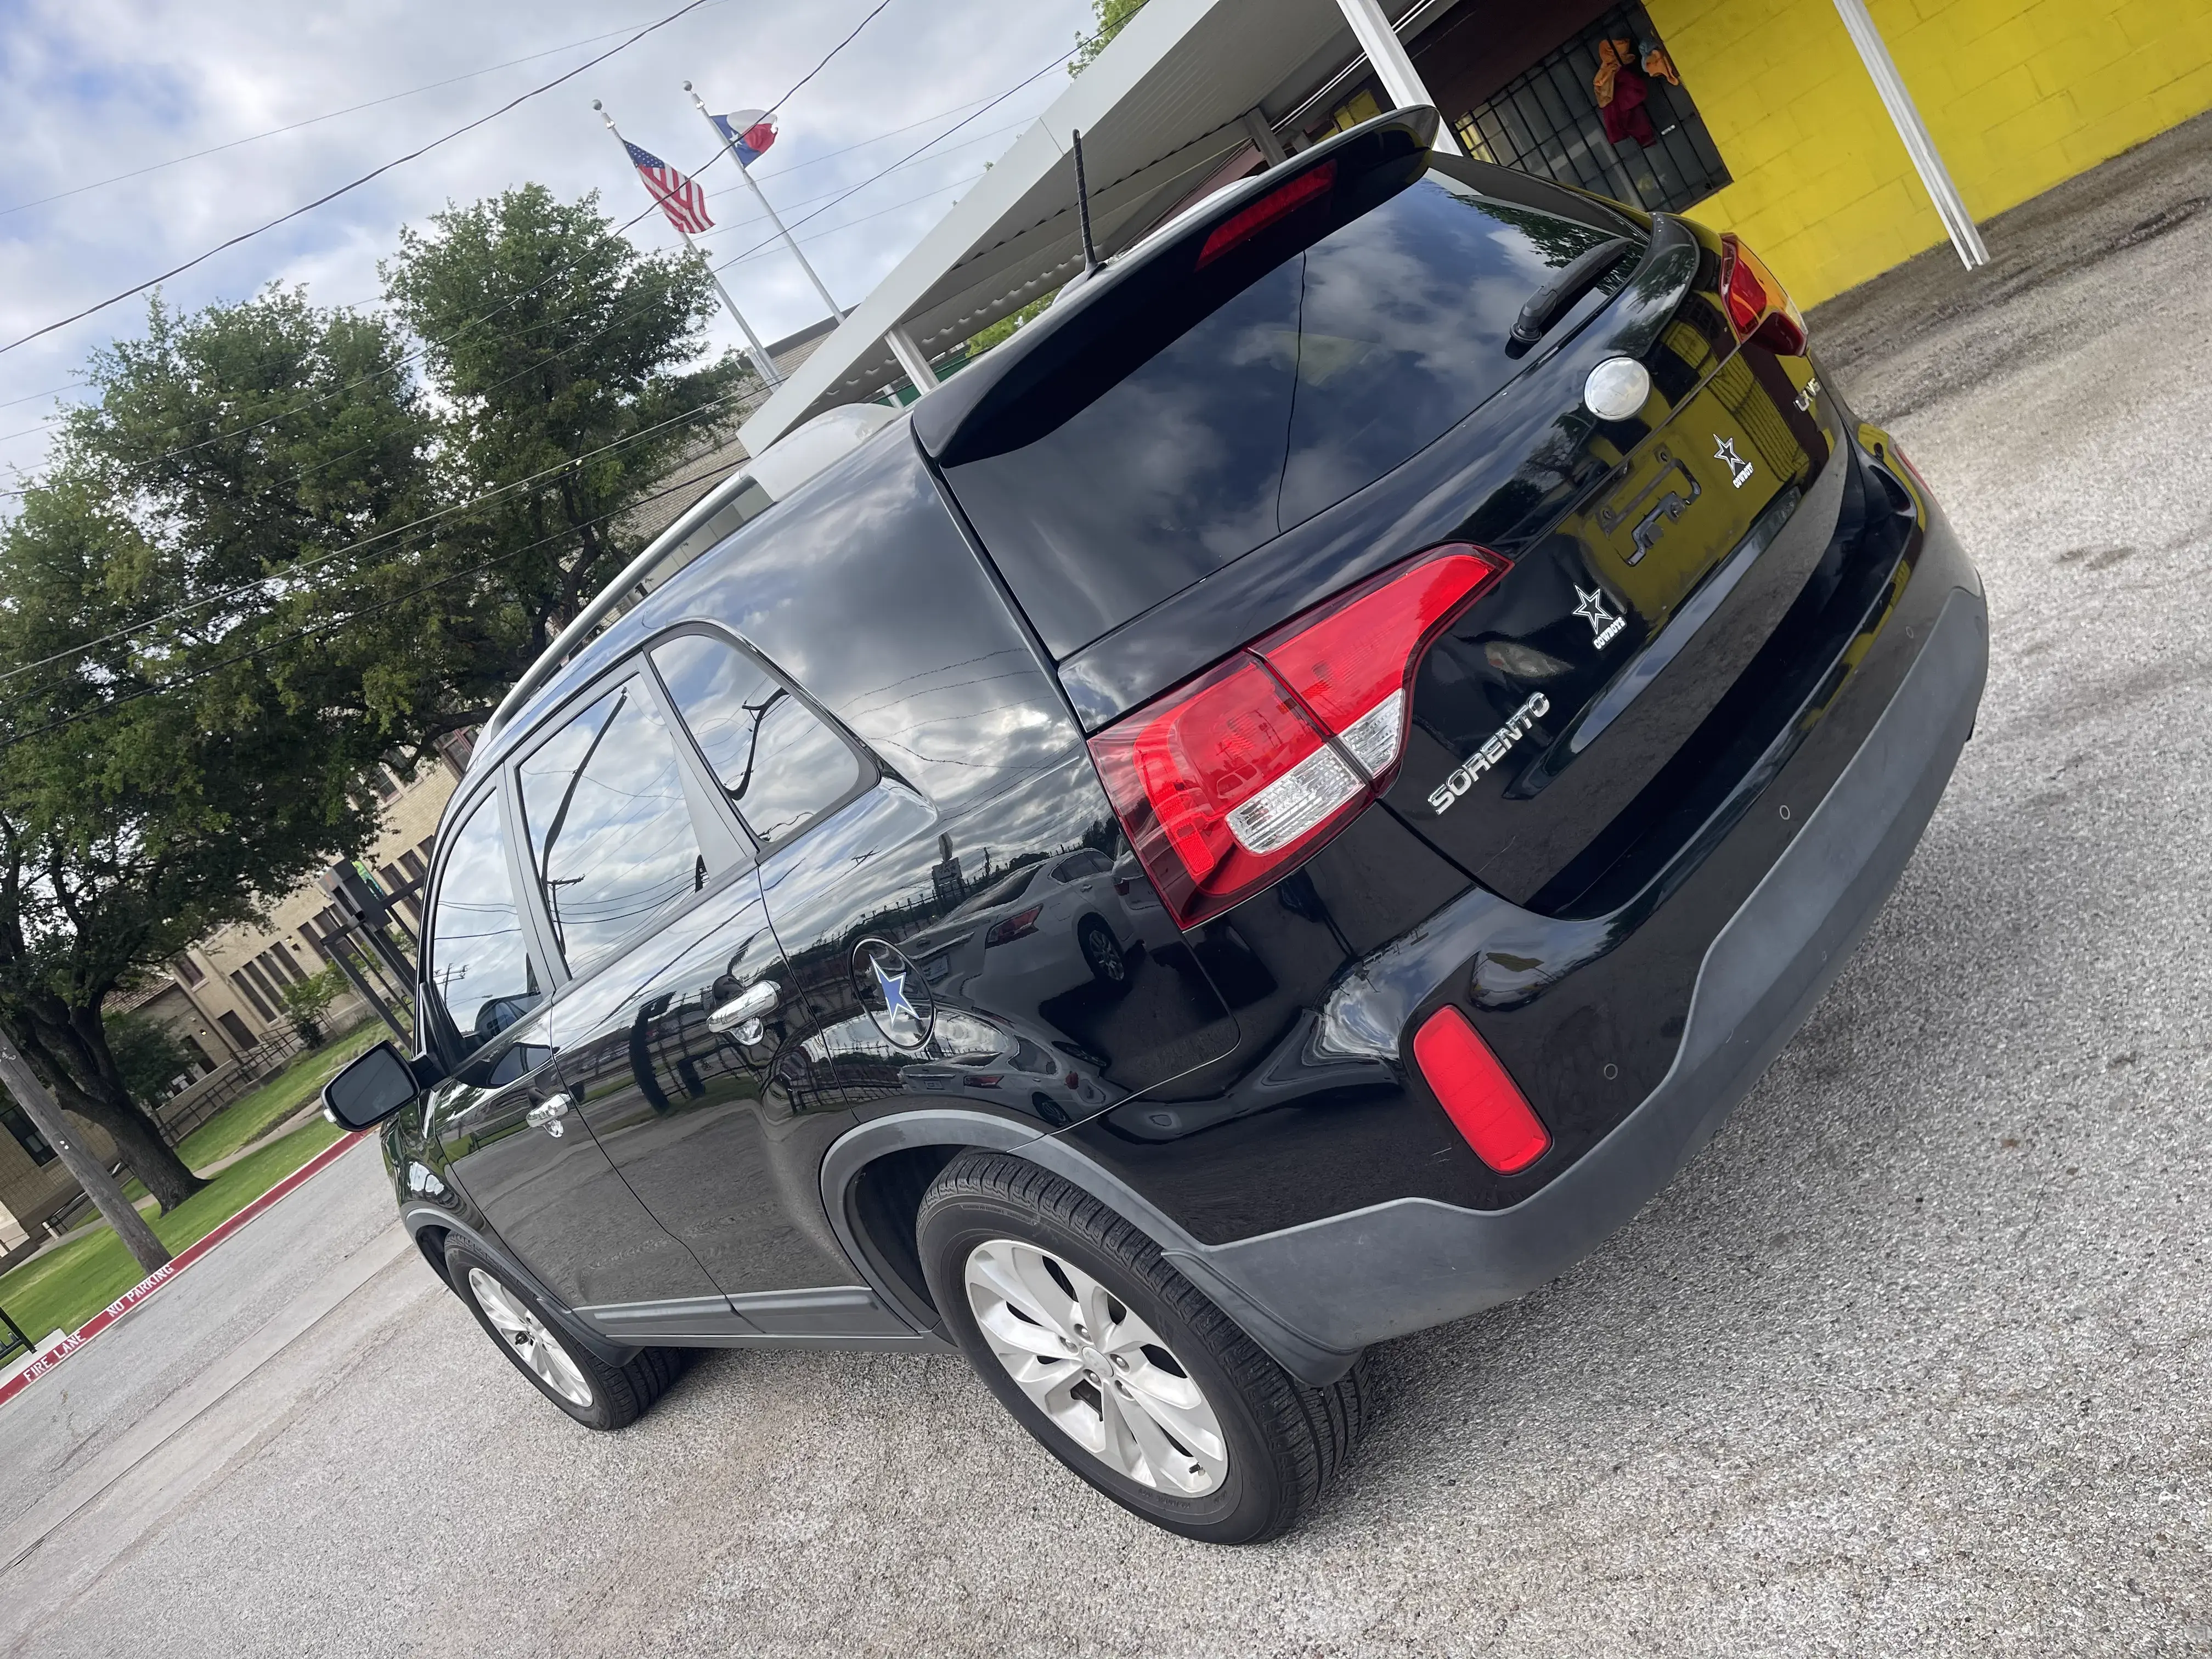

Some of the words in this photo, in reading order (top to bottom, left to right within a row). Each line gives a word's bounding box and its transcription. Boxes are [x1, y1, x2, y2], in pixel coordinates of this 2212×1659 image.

[1593, 617, 1626, 649] COWBOYS
[1427, 691, 1550, 815] SORENTO
[22, 1357, 53, 1383] FIRE
[53, 1331, 86, 1359] LANE
[106, 1300, 125, 1317] NO
[126, 1264, 174, 1303] PARKING
